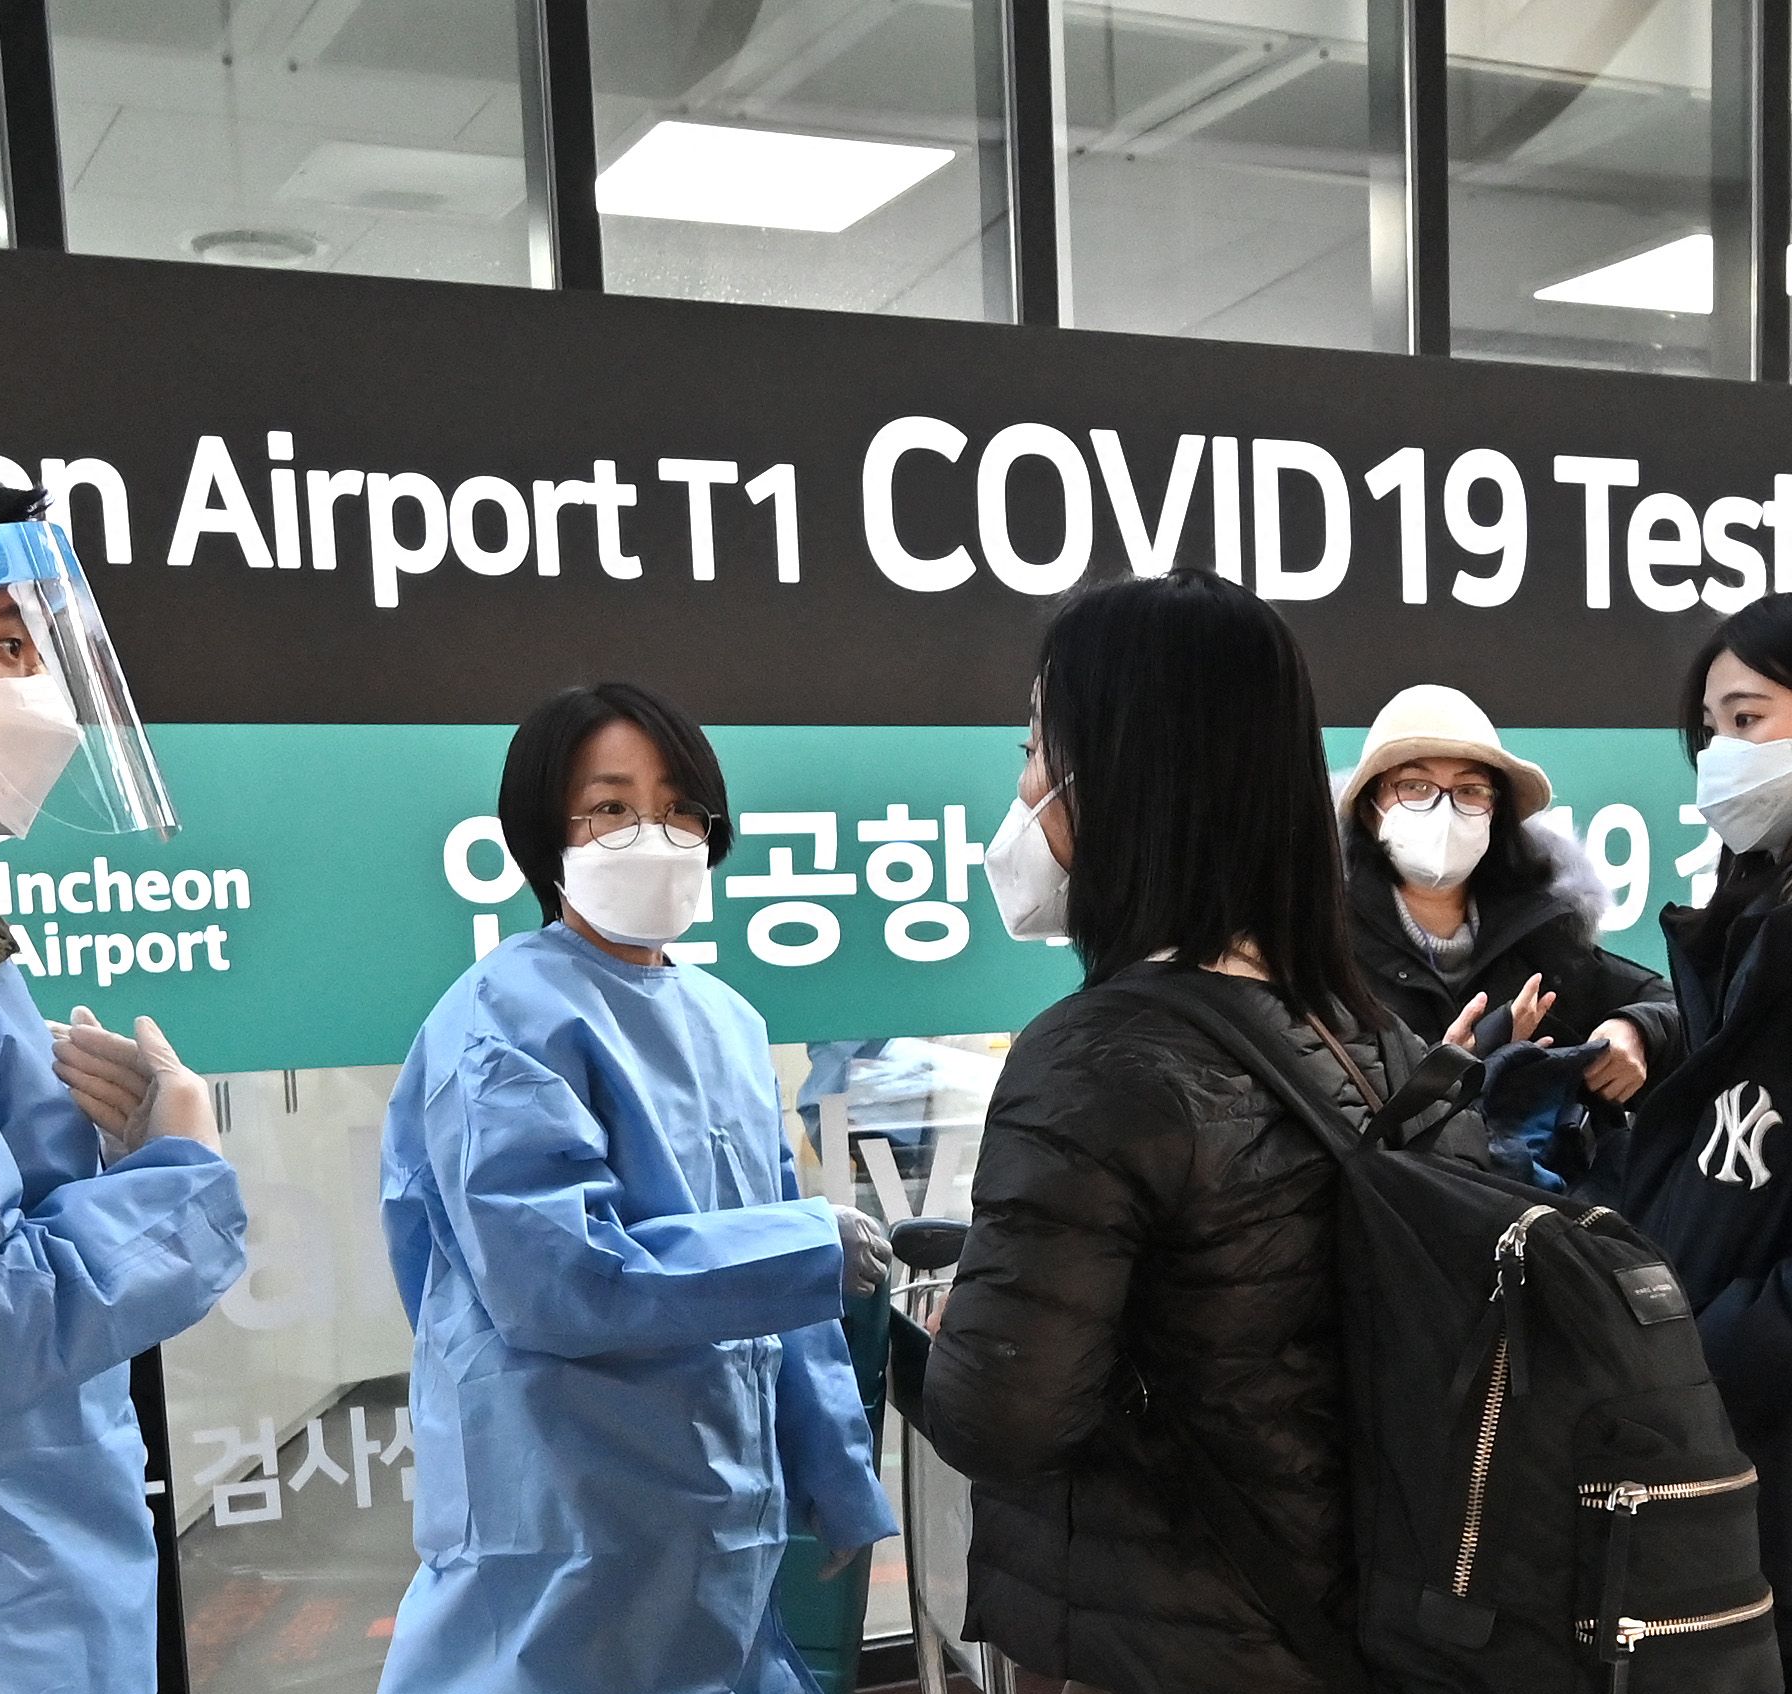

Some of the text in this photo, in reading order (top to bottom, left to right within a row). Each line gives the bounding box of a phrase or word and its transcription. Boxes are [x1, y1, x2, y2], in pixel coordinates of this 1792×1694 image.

[166, 430, 643, 608] Airport
[657, 457, 801, 584] T1
[862, 415, 1528, 608] COVID19
[443, 803, 985, 967] 공항
[8, 921, 232, 988] Airport
[1697, 1080, 1784, 1191] NY
